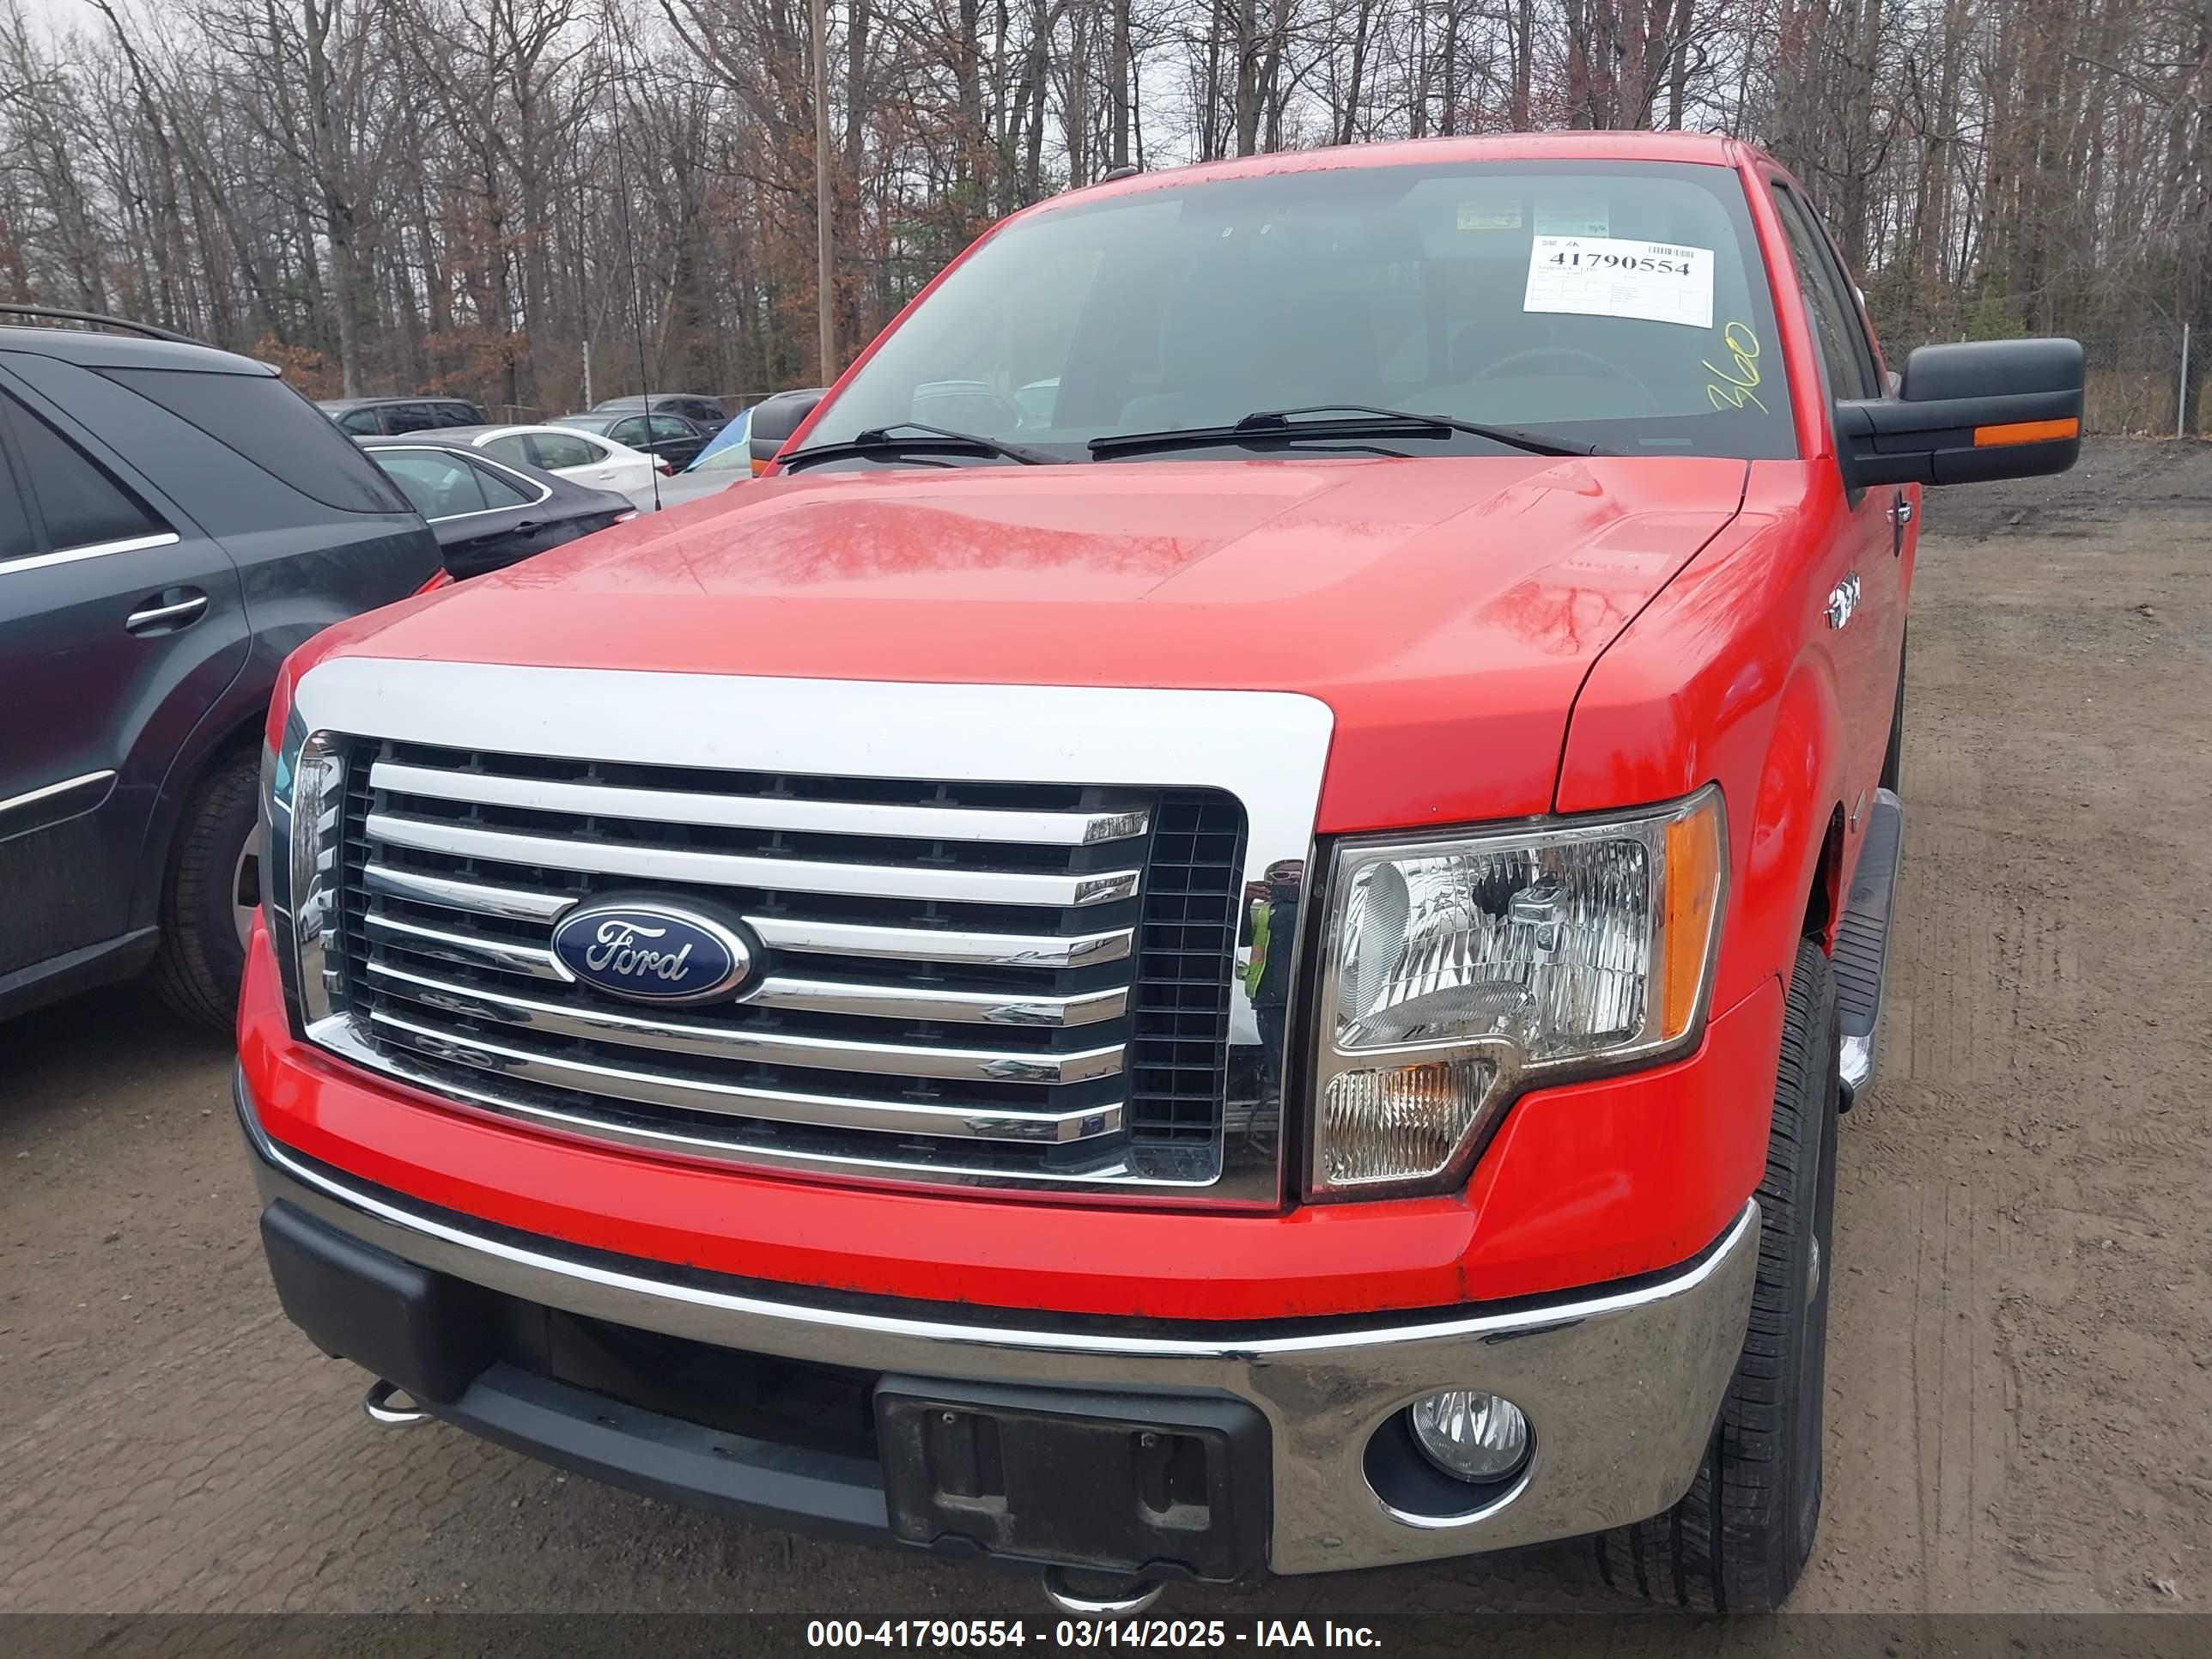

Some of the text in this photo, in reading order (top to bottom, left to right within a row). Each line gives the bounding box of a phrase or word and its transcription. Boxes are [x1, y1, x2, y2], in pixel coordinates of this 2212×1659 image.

[1549, 252, 1691, 276] 41790554
[1701, 321, 1769, 415] 360
[586, 920, 693, 981] Ford
